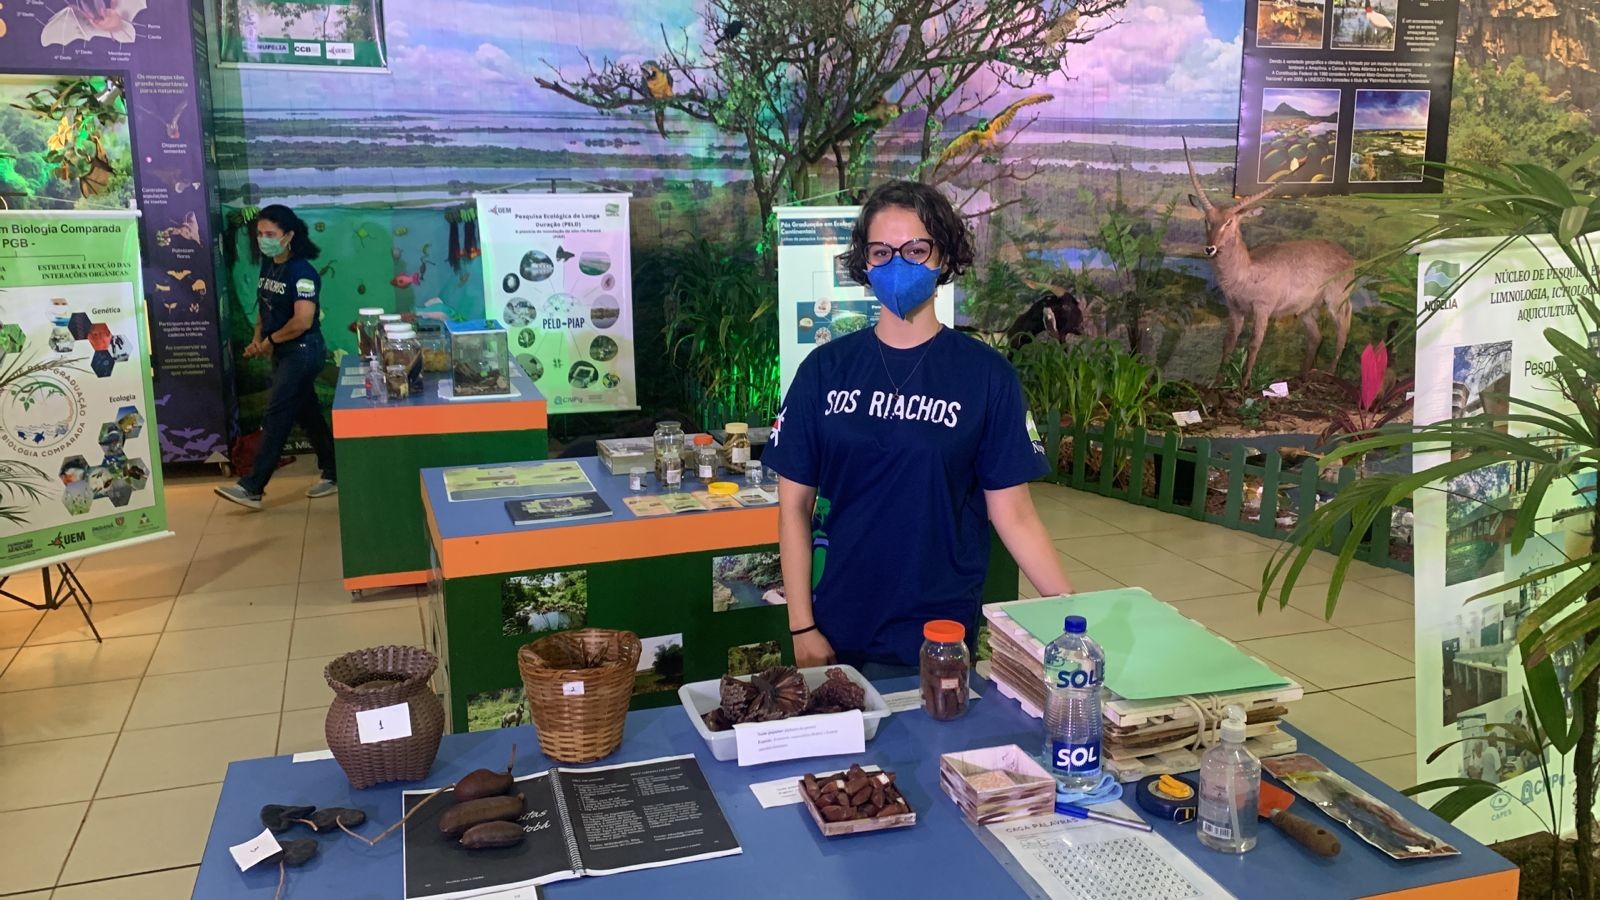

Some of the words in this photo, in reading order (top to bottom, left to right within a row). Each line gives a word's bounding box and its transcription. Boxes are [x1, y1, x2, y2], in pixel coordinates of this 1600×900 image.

[0, 226, 8, 234] m
[12, 224, 58, 236] Biologia
[60, 224, 121, 234] Comparada
[792, 220, 823, 229] Graduação
[2, 238, 28, 248] PGB
[88, 262, 116, 270] FUNÇÃO
[42, 270, 88, 280] INTERAÇÕES
[1495, 270, 1530, 285] NÚCLEO
[1532, 270, 1545, 281] DE
[1490, 292, 1550, 304] LIMNOLOGIA,
[92, 307, 121, 315] Genética
[1518, 304, 1578, 322] AQUICULTURA
[109, 394, 136, 403] Ecologia
[824, 390, 860, 416] SOS
[868, 390, 962, 428] RIACHOS
[2, 434, 38, 458] BIOLOGIA
[42, 422, 86, 458] COMPARADA
[64, 531, 86, 544] UEM
[1057, 670, 1100, 688] SOL
[1056, 746, 1098, 768] SOL
[1491, 809, 1512, 822] CAPES
[1032, 818, 1078, 828] PALAVRAS
